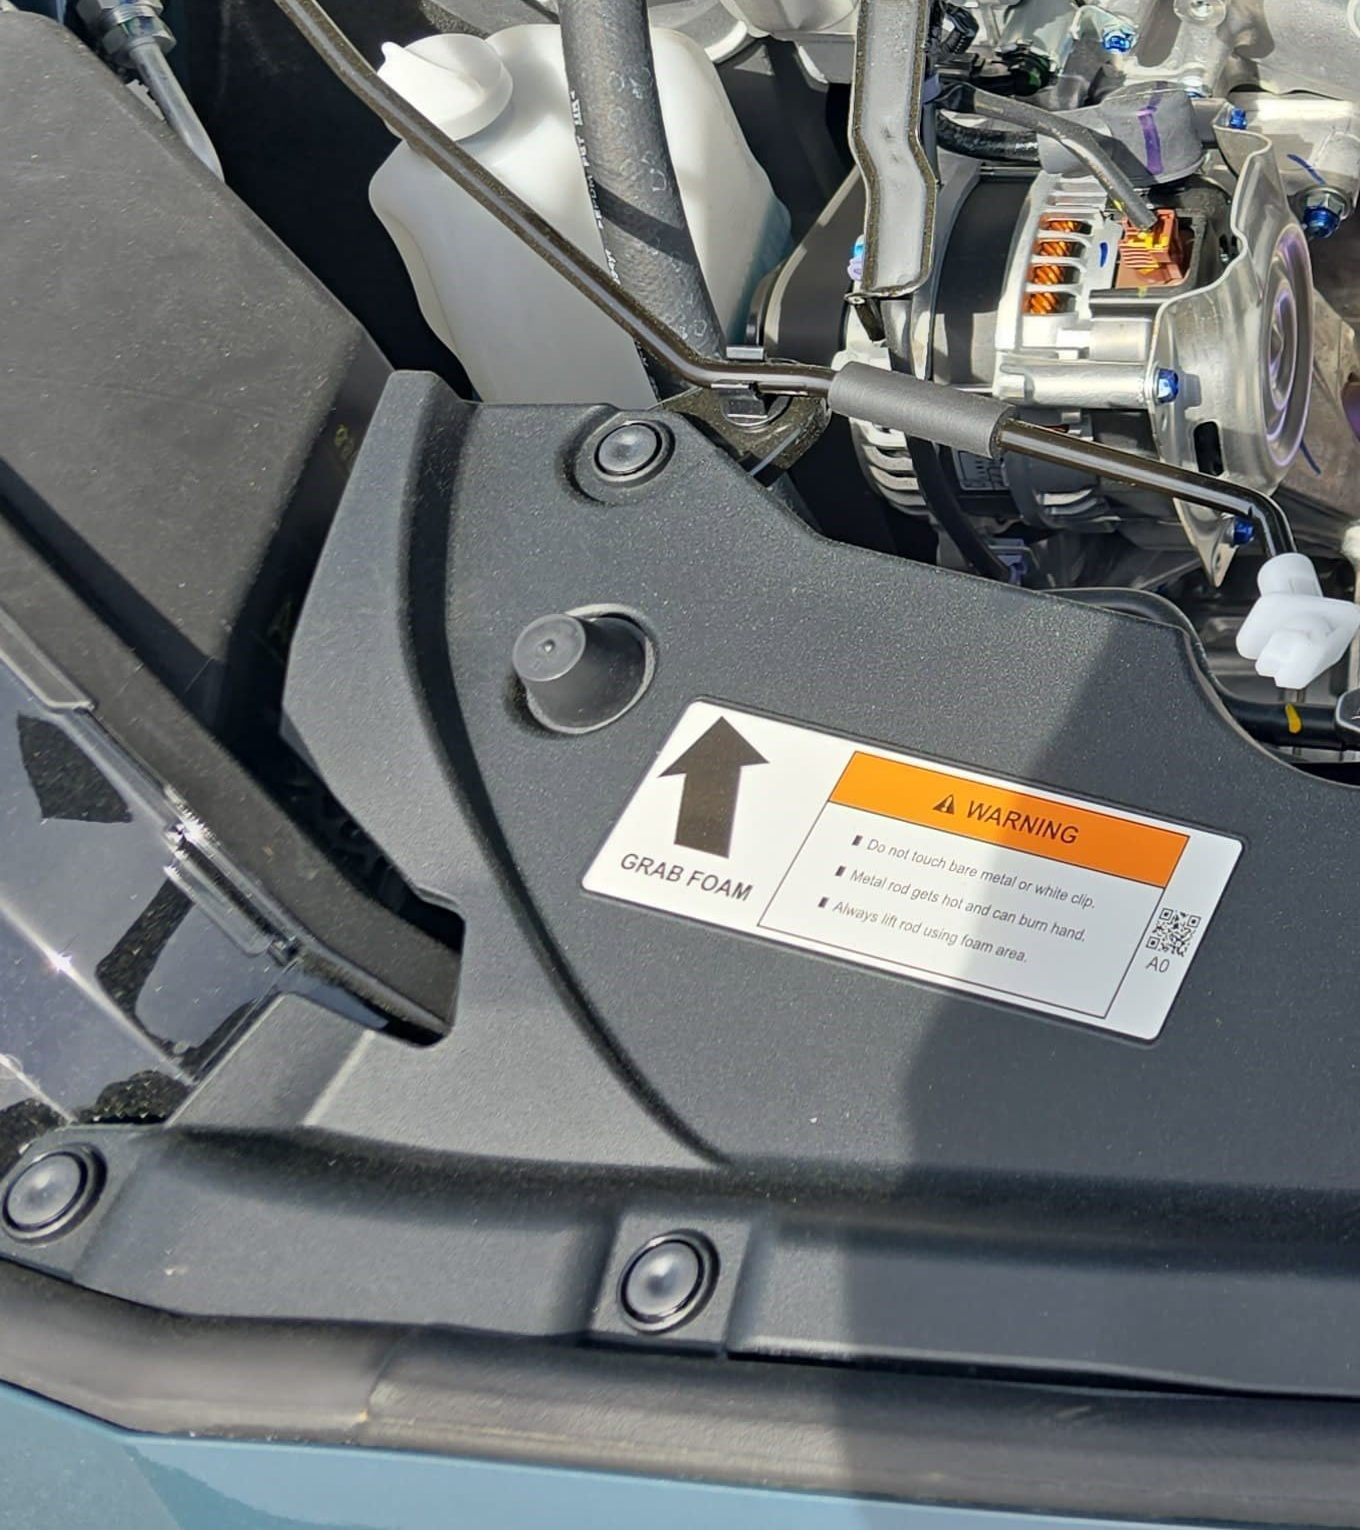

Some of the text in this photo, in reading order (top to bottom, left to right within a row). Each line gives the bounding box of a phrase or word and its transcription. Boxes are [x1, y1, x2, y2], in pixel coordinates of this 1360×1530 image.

[966, 800, 1080, 845] WARNING
[620, 853, 754, 902] GRAB FOAM
[867, 838, 1096, 910] Do not touch bare metal or white clip.
[832, 901, 1028, 964] Always lift rod using foam area.
[850, 869, 1086, 943] Metal rod gets hot and can burn hand.
[1145, 955, 1171, 974] A0
